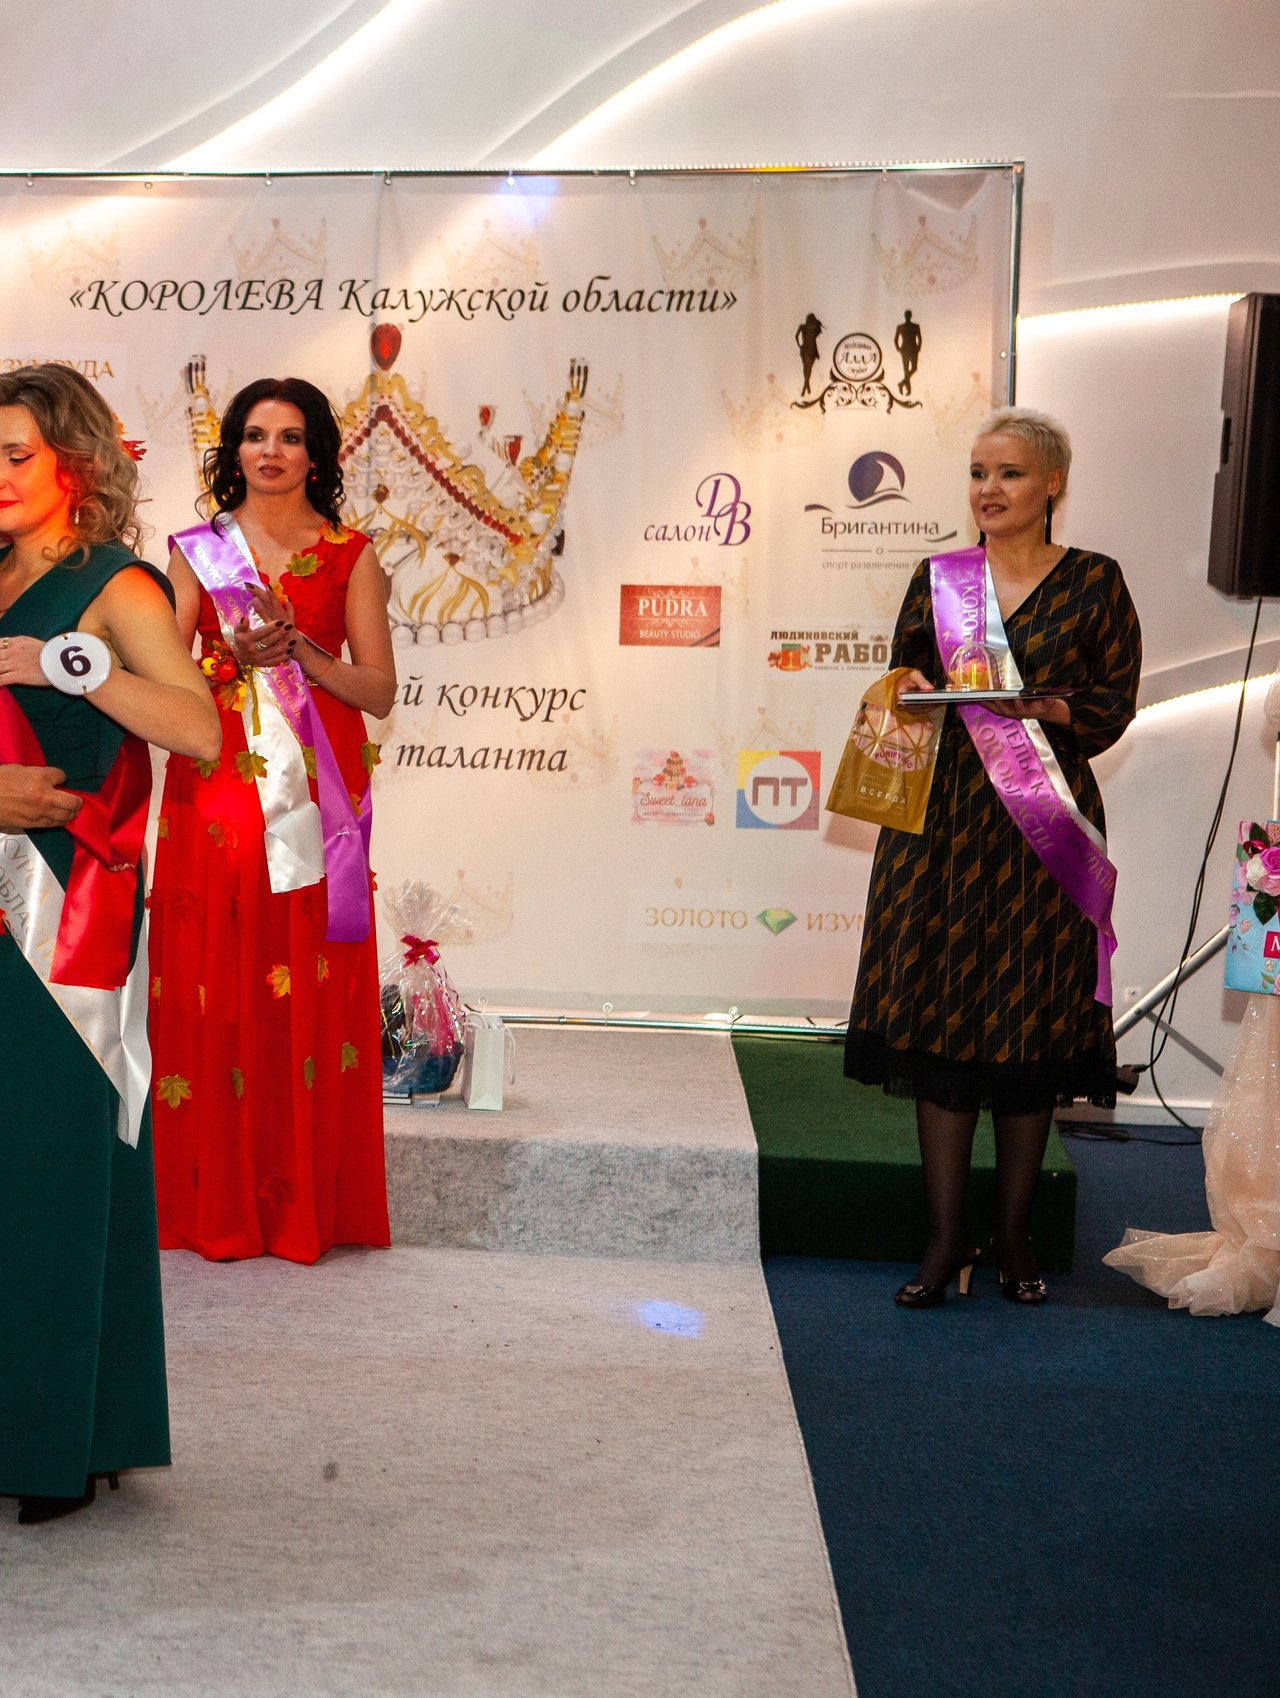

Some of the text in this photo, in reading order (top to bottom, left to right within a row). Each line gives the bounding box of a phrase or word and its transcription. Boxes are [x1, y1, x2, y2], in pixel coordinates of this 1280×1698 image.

[69, 275, 738, 323] «КОРОЛЕВА Калужской области»
[643, 524, 712, 542] салон
[821, 516, 940, 540] Бригантина
[821, 561, 849, 570] спорт
[850, 561, 910, 570] развлечение
[638, 598, 708, 617] PUDRA
[640, 630, 700, 639] BEAUTY STUDIO
[770, 631, 860, 641] ЛЮДИНОВСКИЙ
[60, 645, 92, 677] 6
[815, 643, 888, 664] РАБО
[437, 683, 587, 723] конкурс
[395, 744, 569, 772] таланта
[751, 776, 808, 807] ПТ
[860, 786, 906, 805] ВСЕГДА
[644, 906, 749, 930] ЗОЛОТО
